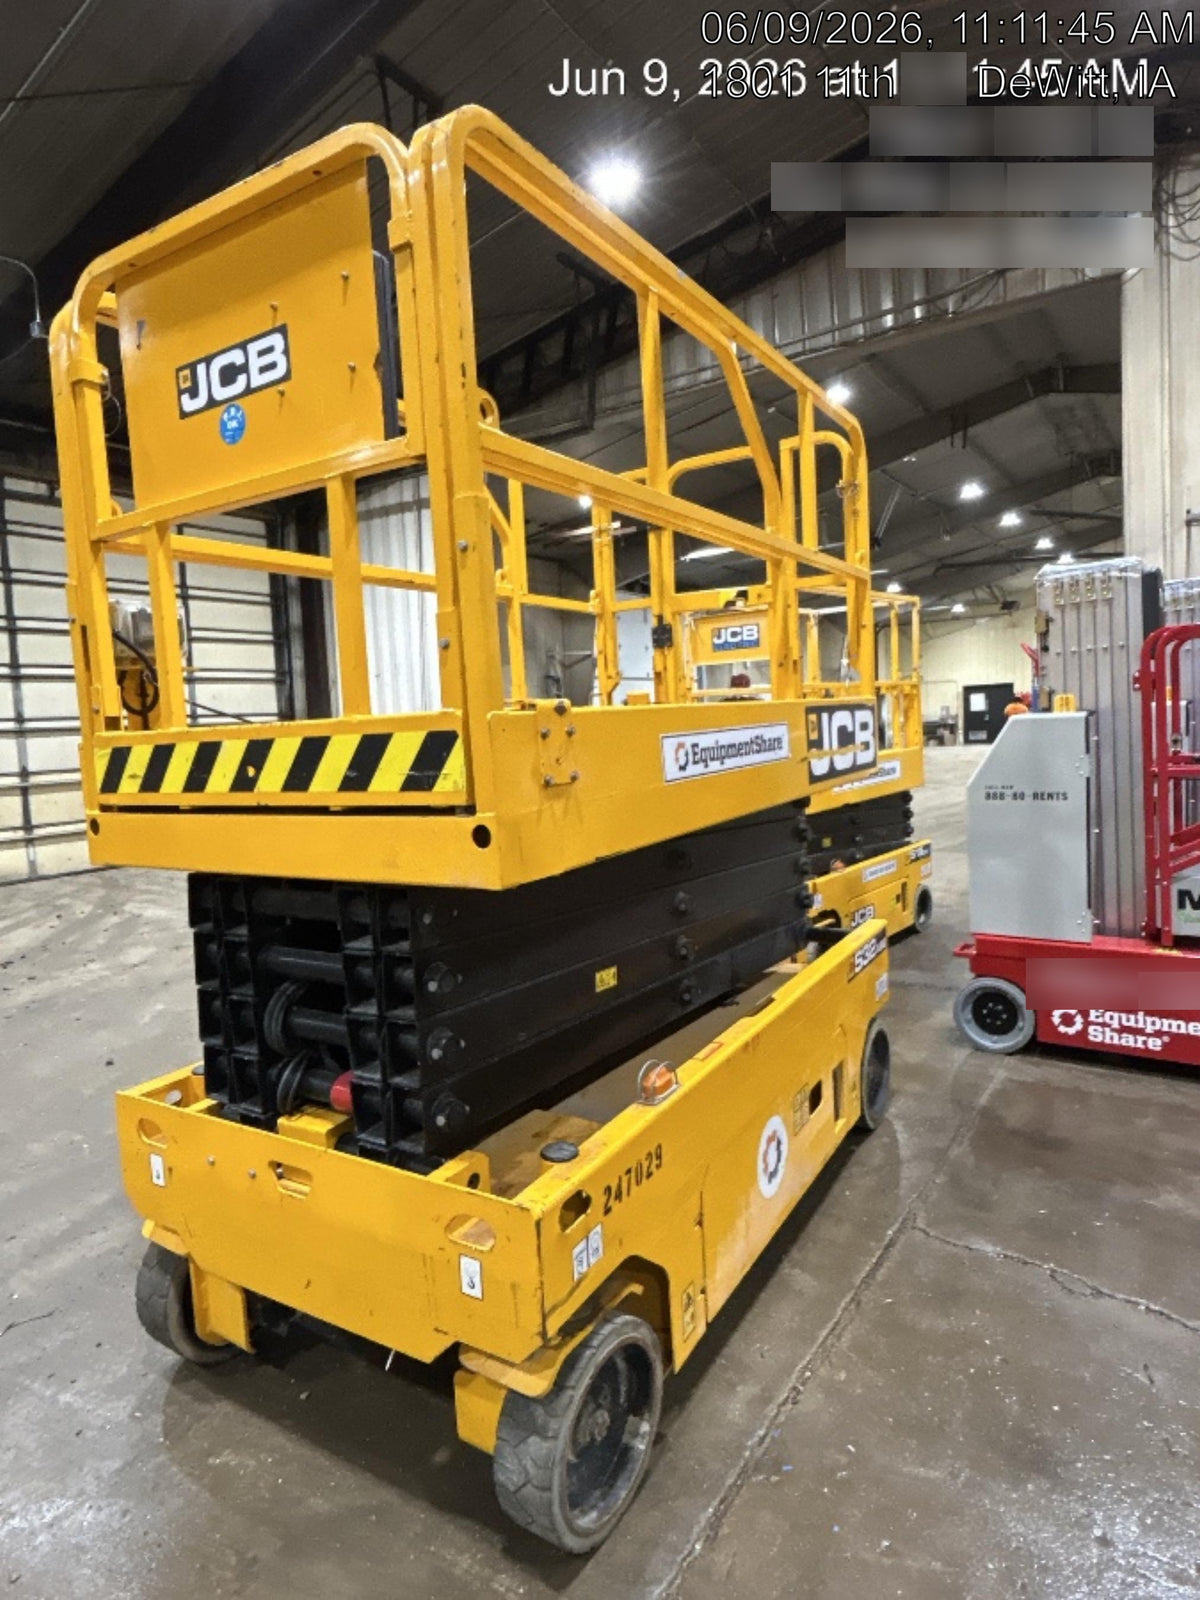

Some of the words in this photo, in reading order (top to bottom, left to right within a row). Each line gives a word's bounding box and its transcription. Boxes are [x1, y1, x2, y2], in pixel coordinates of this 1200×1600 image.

[180, 332, 287, 412] JCB
[713, 625, 759, 644] JCB
[691, 735, 783, 768] EquipmentShare
[810, 709, 875, 776] JCB
[603, 1143, 662, 1216] 247029
